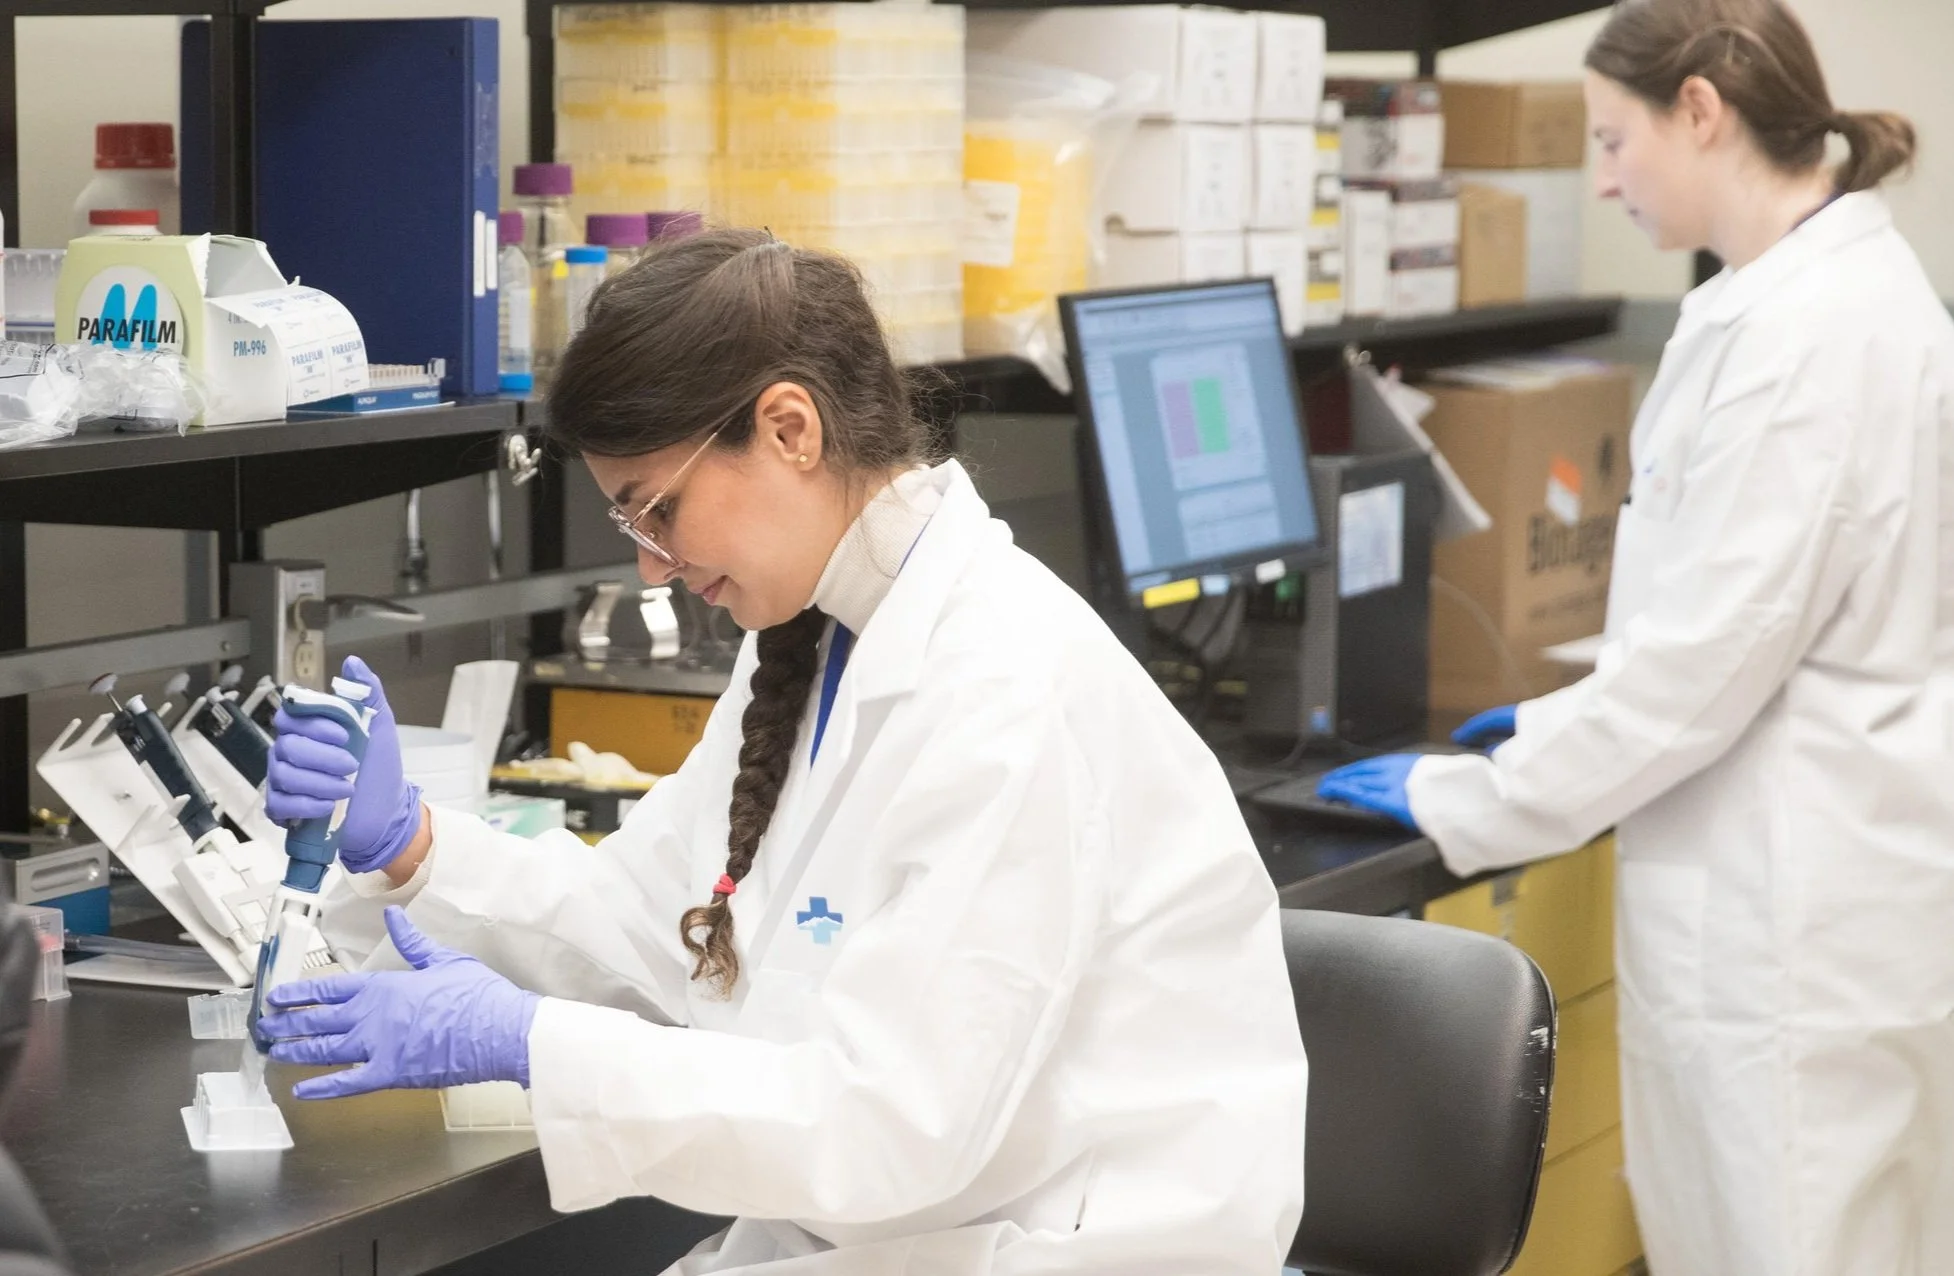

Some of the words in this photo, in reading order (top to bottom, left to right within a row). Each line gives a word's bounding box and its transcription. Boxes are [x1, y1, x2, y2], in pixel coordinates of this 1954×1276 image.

[77, 317, 176, 343] PARAFILM
[233, 340, 267, 357] PM-996
[331, 339, 363, 356] PARAFILM
[291, 349, 324, 366] PARAFILM
